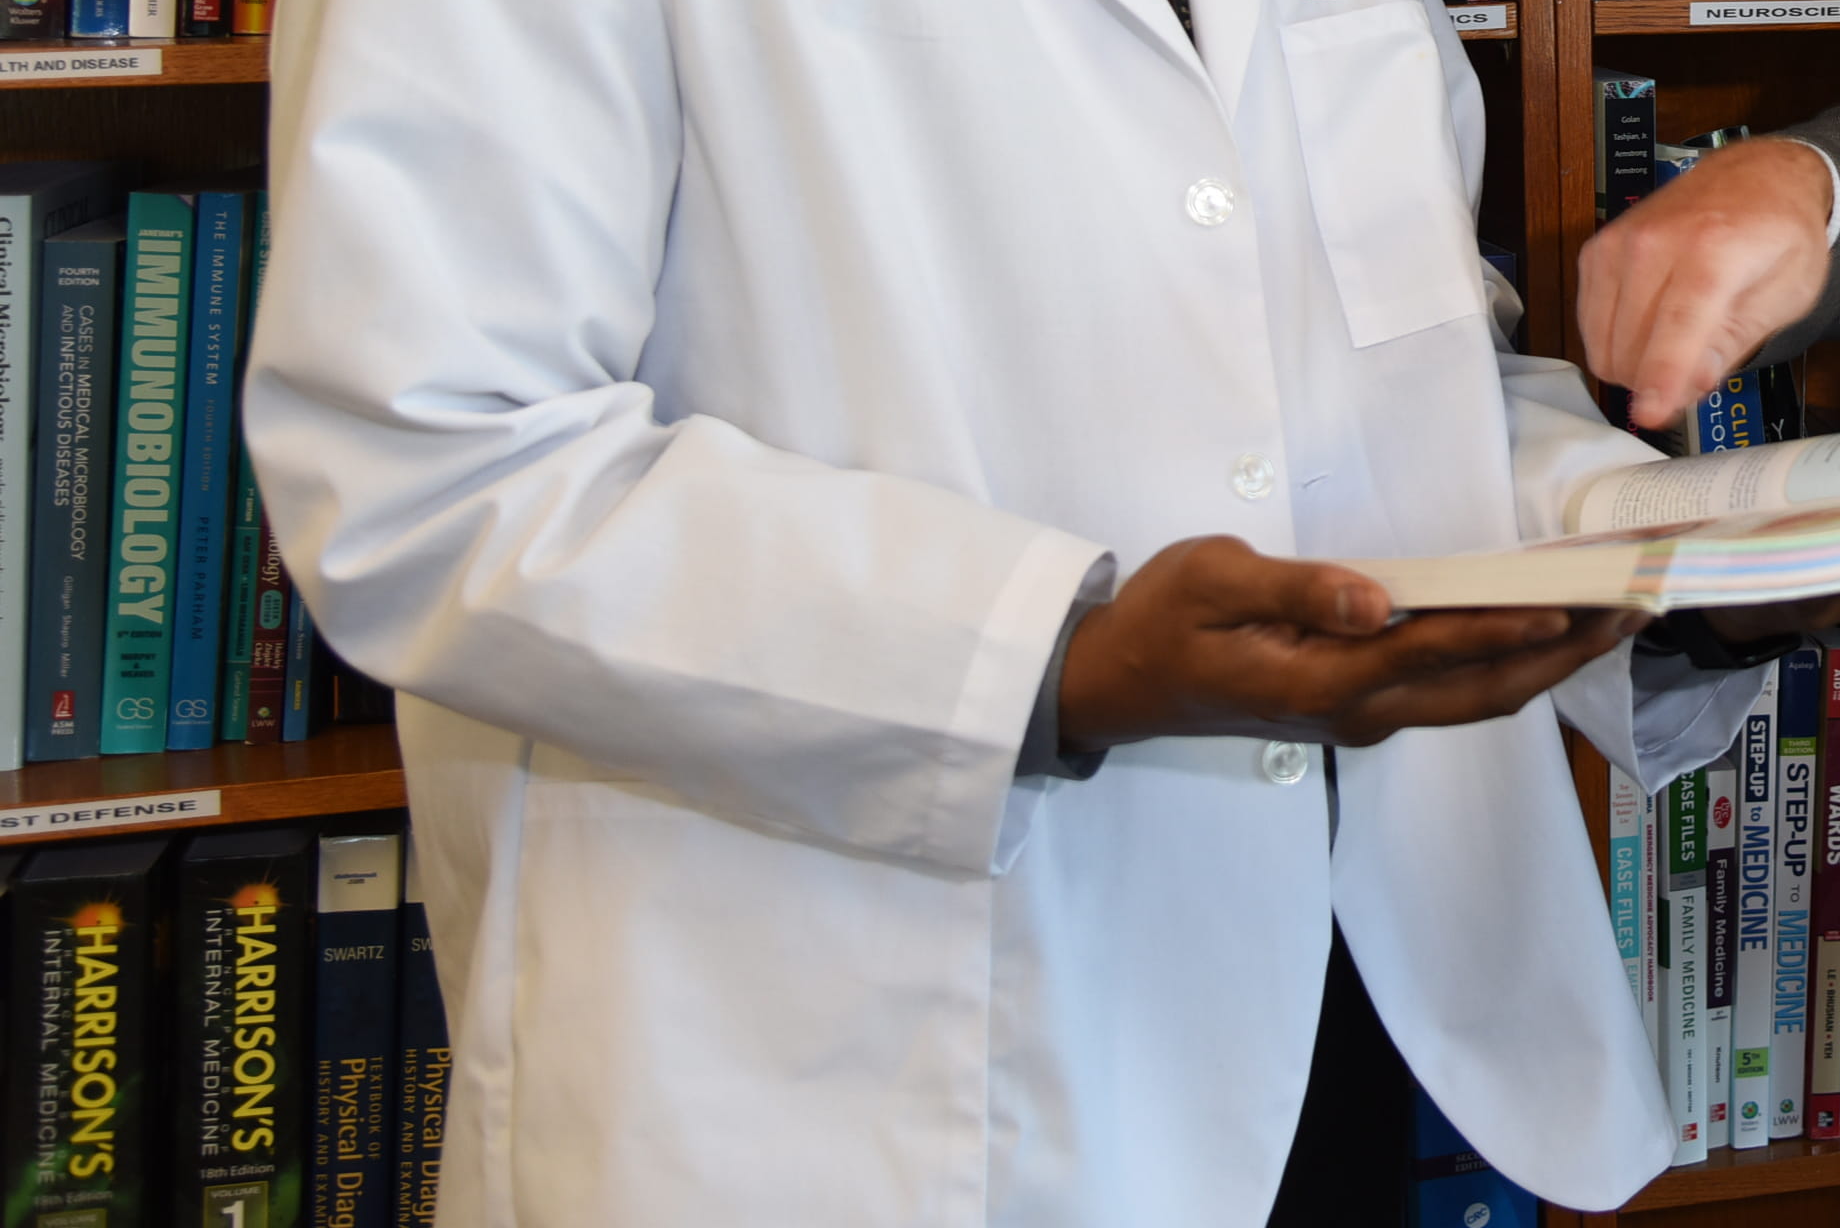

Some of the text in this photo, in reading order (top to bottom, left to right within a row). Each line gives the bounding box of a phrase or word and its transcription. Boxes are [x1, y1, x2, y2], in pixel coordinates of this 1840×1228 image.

[33, 59, 66, 72] AND
[70, 56, 140, 71] DISEASE
[1621, 115, 1641, 124] Golan
[205, 211, 228, 386] THE IMMUNE SYSTEM
[54, 304, 75, 507] AND INFECTIOUS DISEASES
[70, 304, 95, 561] CASES IN MEDICAL MICROBIOLOGY
[117, 238, 183, 625] IMMUNOBIOLOGY
[116, 697, 155, 721] GS
[50, 799, 198, 824] DEFENSE
[1646, 824, 1654, 872] EMERGENCY
[1680, 815, 1696, 862] FILES
[1739, 720, 1770, 952] STEP-UP to MEDICINE
[1616, 846, 1633, 949] CASE FILES
[1646, 874, 1654, 913] MEDICINE
[1713, 858, 1728, 915] Family
[1774, 762, 1810, 1035] STEP-UP TO MEDICINE
[323, 944, 385, 962] SWARTZ
[1681, 895, 1696, 1040] FAMILY MEDICINE
[1713, 919, 1727, 998] Medicine
[37, 930, 62, 1186] INTERNAL MEDICINE
[70, 925, 119, 1181] HARRISON'S
[201, 909, 223, 1157] INTERNAL MEDICINE
[232, 905, 278, 1153] HARRISON'S
[1823, 968, 1837, 1060] LE BHUSHAN YEH
[335, 1057, 367, 1161] Physical
[1773, 1114, 1799, 1127] LWW
